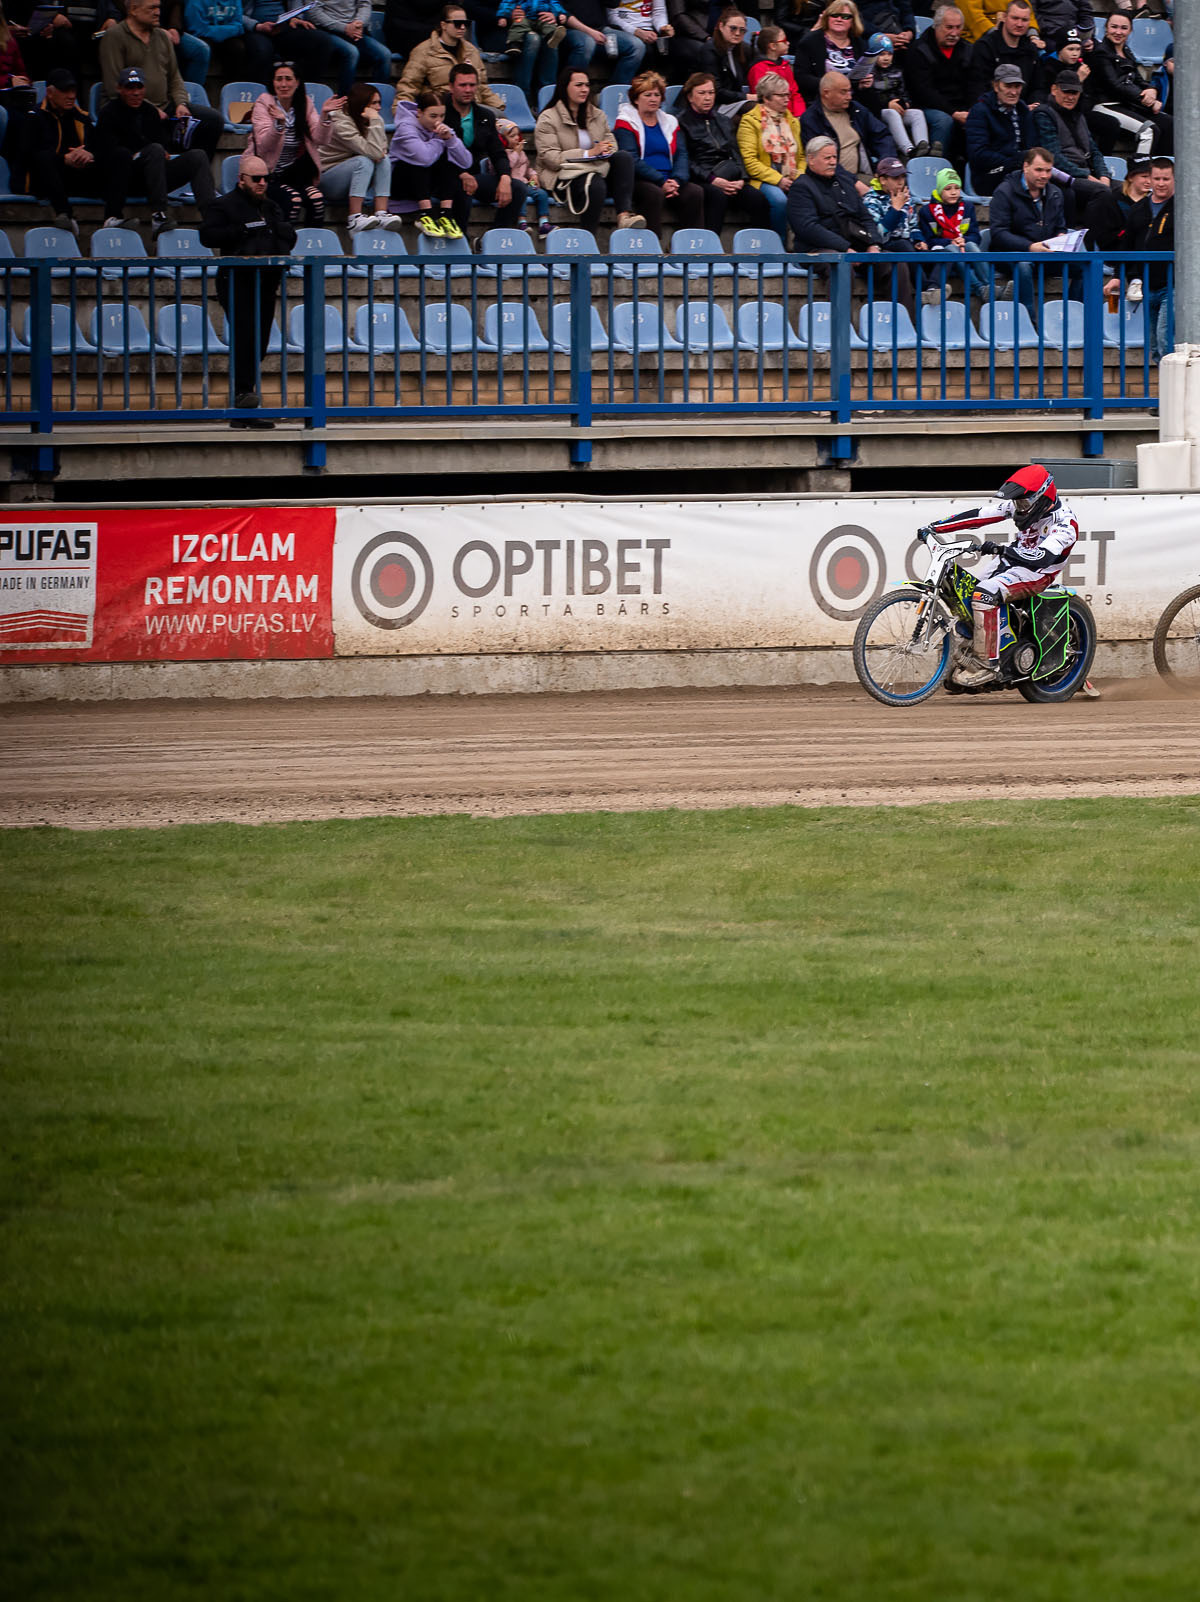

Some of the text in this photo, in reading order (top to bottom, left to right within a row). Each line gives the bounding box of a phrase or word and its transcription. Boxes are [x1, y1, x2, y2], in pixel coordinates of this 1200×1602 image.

[240, 92, 252, 102] 22
[43, 237, 56, 247] 17
[306, 239, 322, 248] 21
[373, 239, 386, 249] 22
[501, 238, 512, 248] 24
[566, 238, 579, 248] 25
[630, 238, 643, 248] 26
[690, 238, 703, 249] 27
[373, 312, 387, 324] 21
[503, 312, 515, 323] 23
[694, 312, 706, 324] 26
[878, 312, 890, 323] 29
[0, 529, 91, 560] PUFAS
[172, 532, 295, 563] IZCILAM
[452, 538, 671, 598] OPTIBET
[26, 577, 36, 589] IN
[41, 576, 90, 589] GERMANY
[144, 574, 319, 605] REMONTAM
[451, 599, 669, 617] SPORTA BĀRS
[144, 613, 317, 635] WWW.PUFAS.LV
